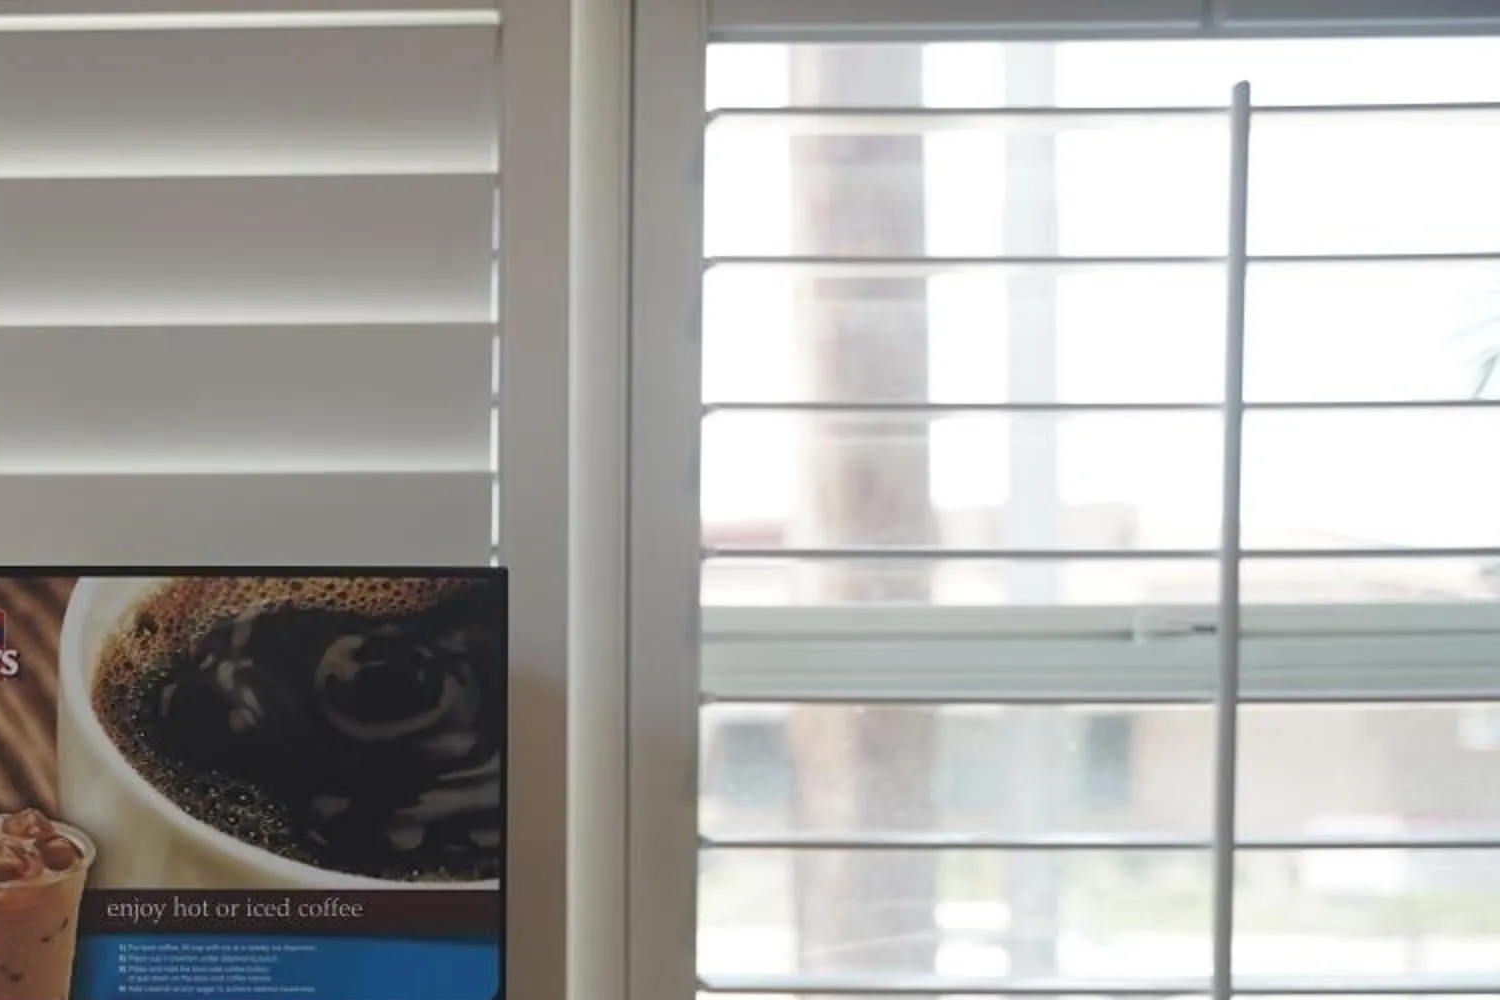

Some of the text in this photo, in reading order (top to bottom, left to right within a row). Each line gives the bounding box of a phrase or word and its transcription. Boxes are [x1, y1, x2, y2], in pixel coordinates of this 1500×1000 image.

[107, 895, 365, 923] enjoy hot or iced coffee
